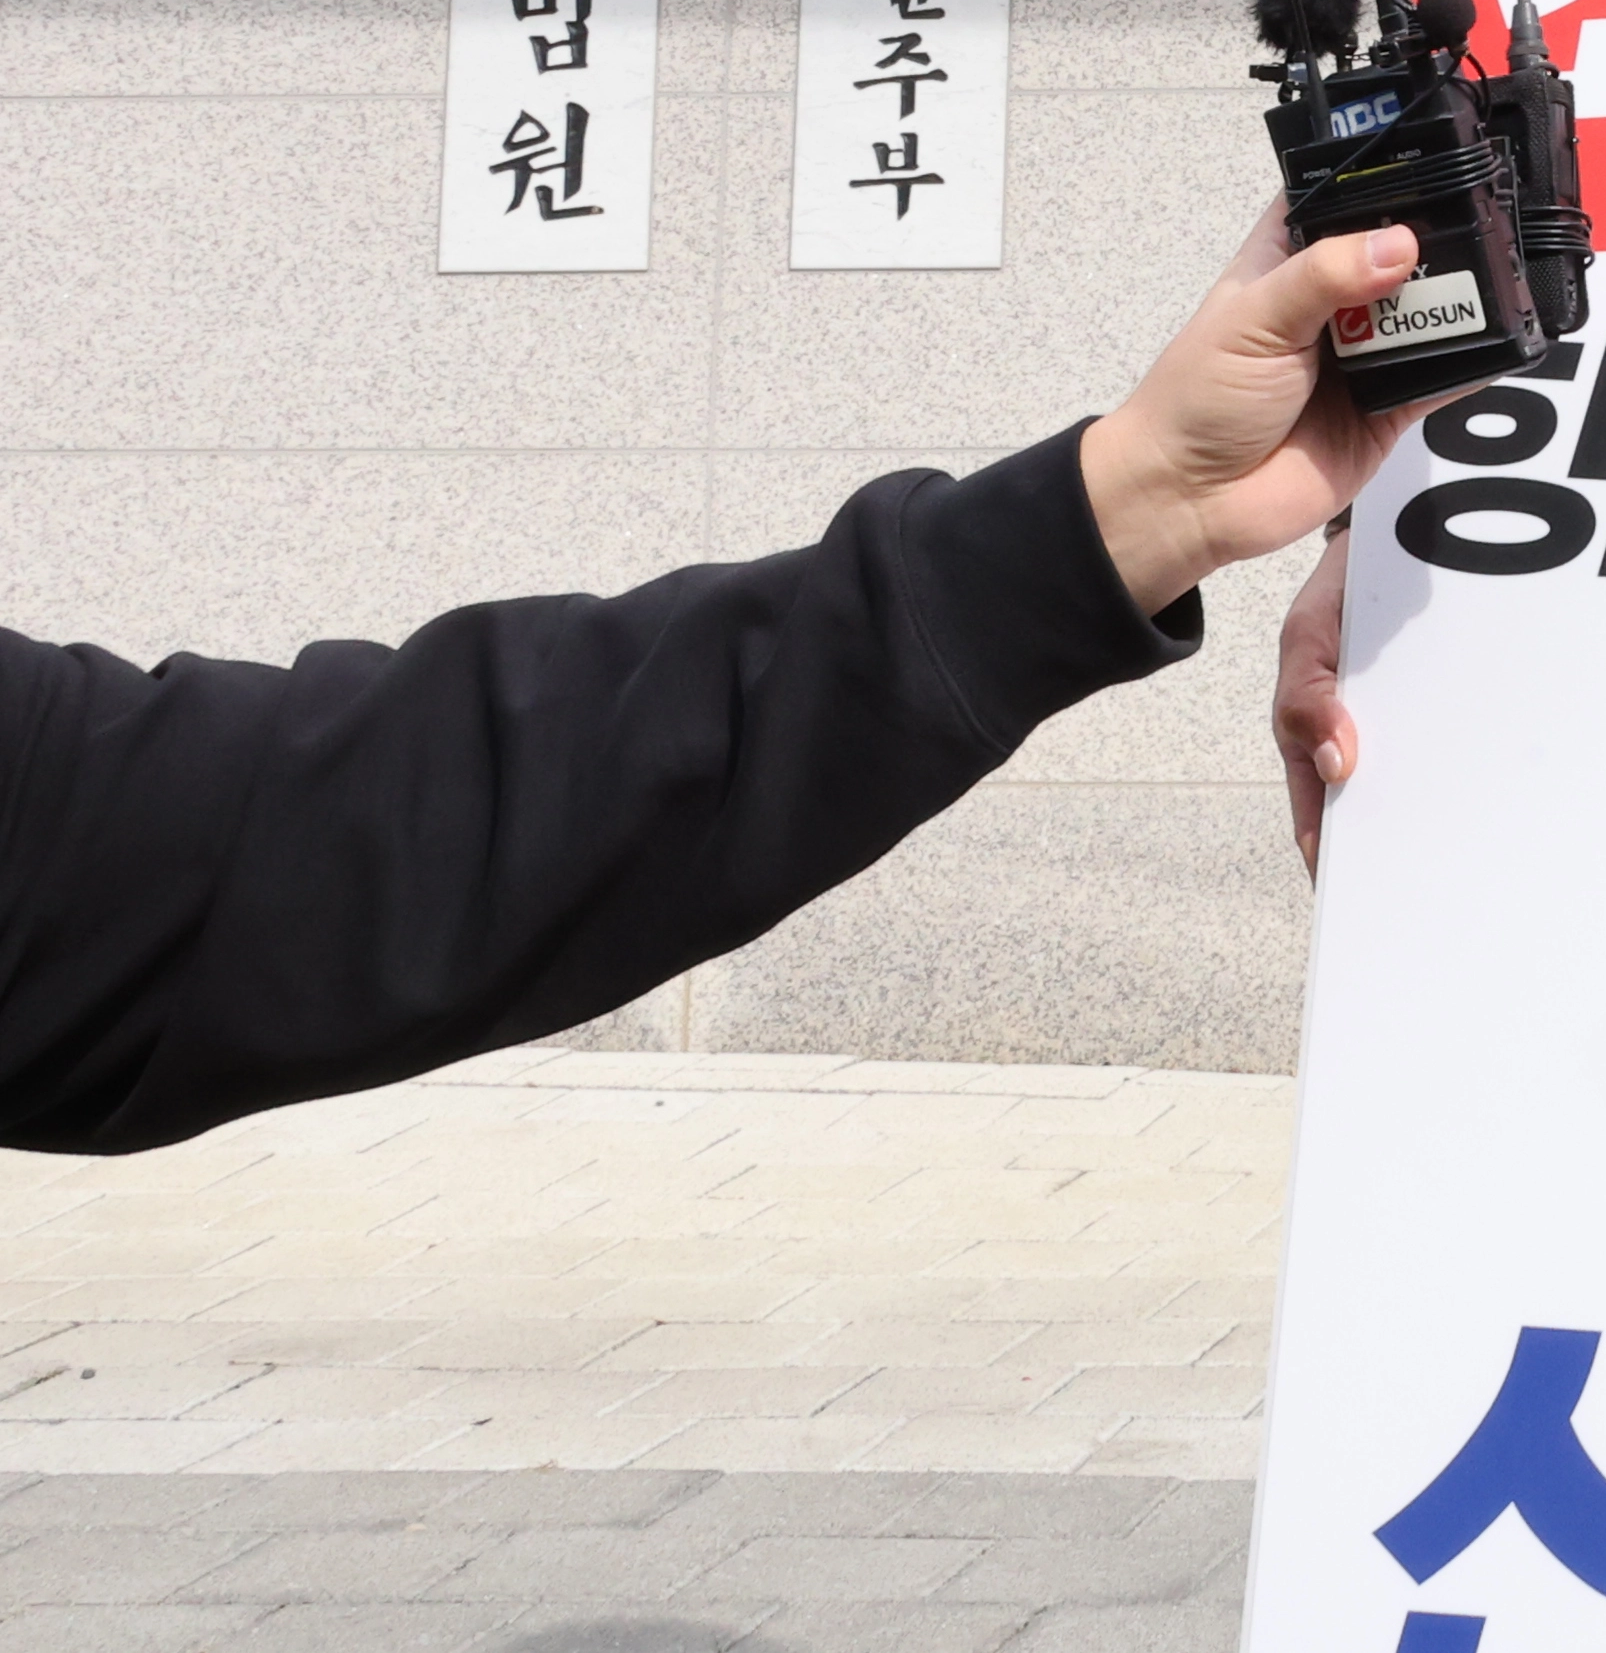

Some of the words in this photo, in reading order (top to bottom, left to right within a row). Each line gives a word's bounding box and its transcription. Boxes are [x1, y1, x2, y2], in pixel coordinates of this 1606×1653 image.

[1396, 148, 1422, 160] AUDIO
[1375, 296, 1400, 314] TV
[1378, 300, 1476, 337] CHOSUN
